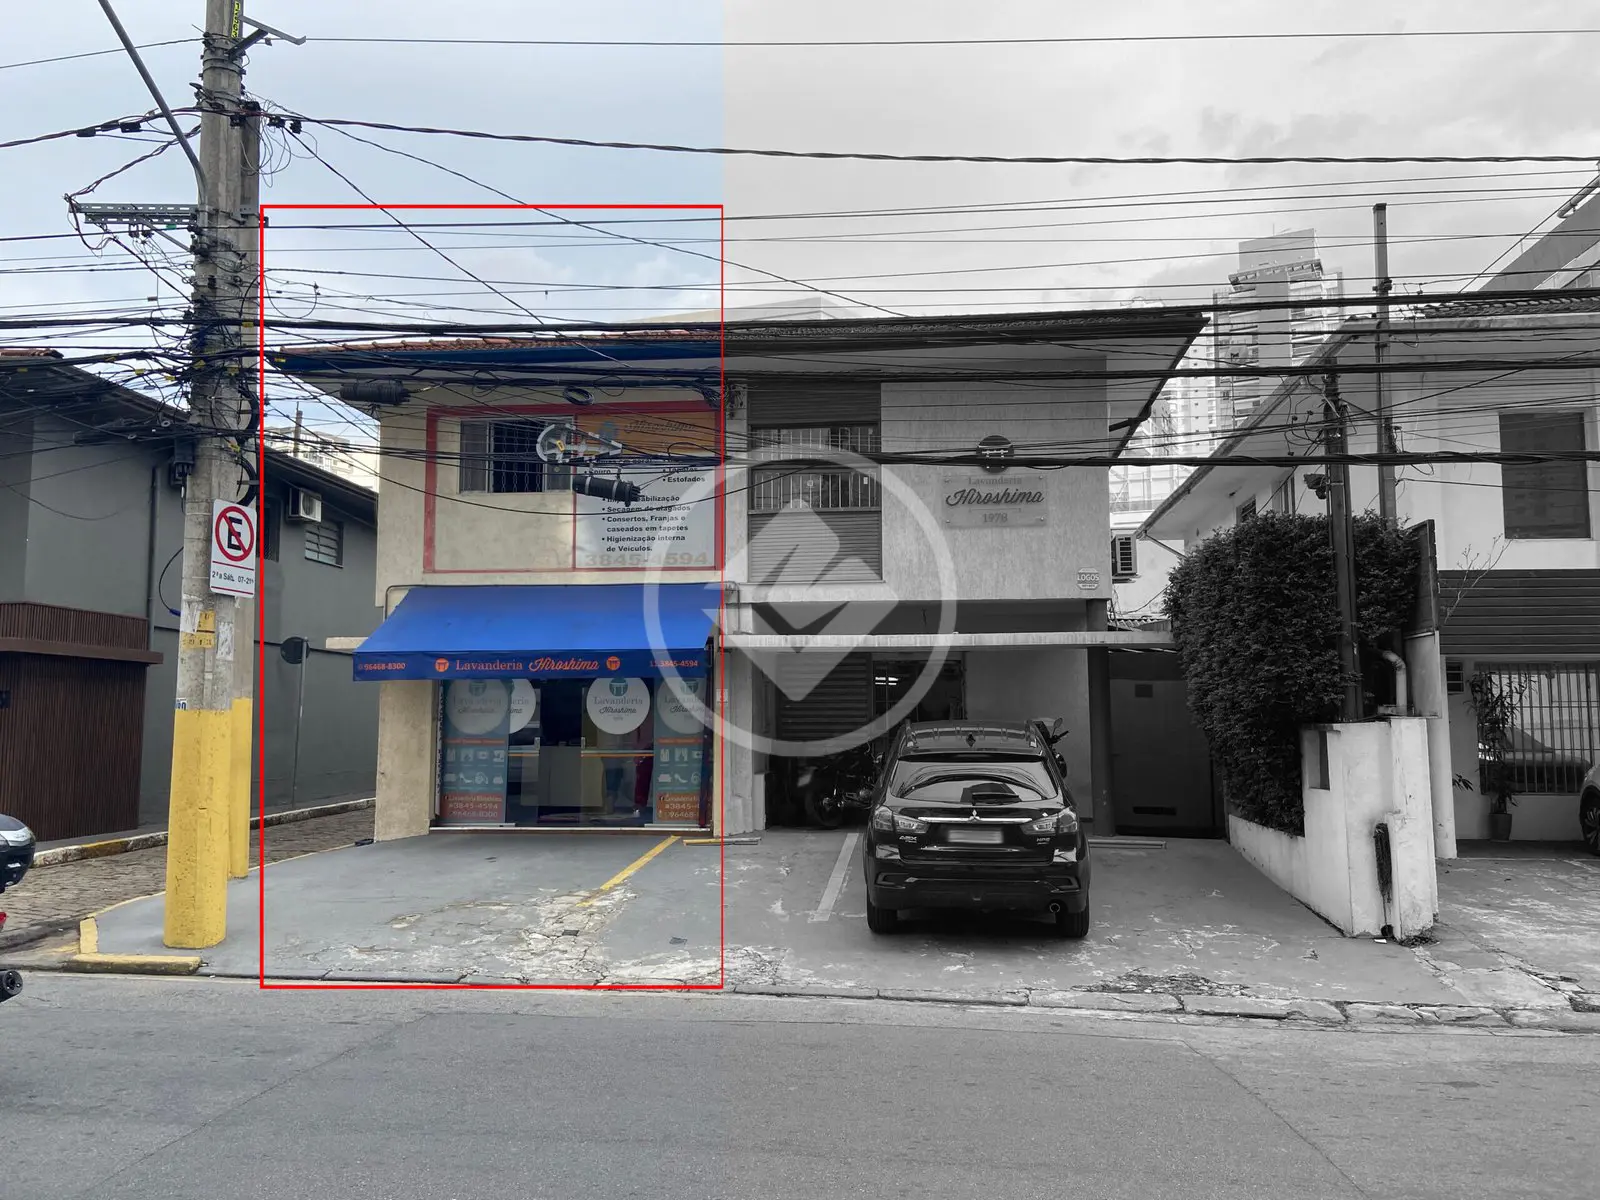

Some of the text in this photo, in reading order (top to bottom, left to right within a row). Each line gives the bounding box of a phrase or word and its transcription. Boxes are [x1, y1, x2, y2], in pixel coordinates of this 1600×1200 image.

[968, 476, 1022, 485] Lavanderia
[945, 488, 1045, 507] Hiroshima
[650, 515, 679, 524] Franjas
[227, 516, 243, 551] E
[659, 525, 689, 533] tapetes
[607, 535, 656, 543] Higienização
[455, 657, 600, 672] Lavanderia Hiroshima
[594, 696, 643, 705] Lavanderia
